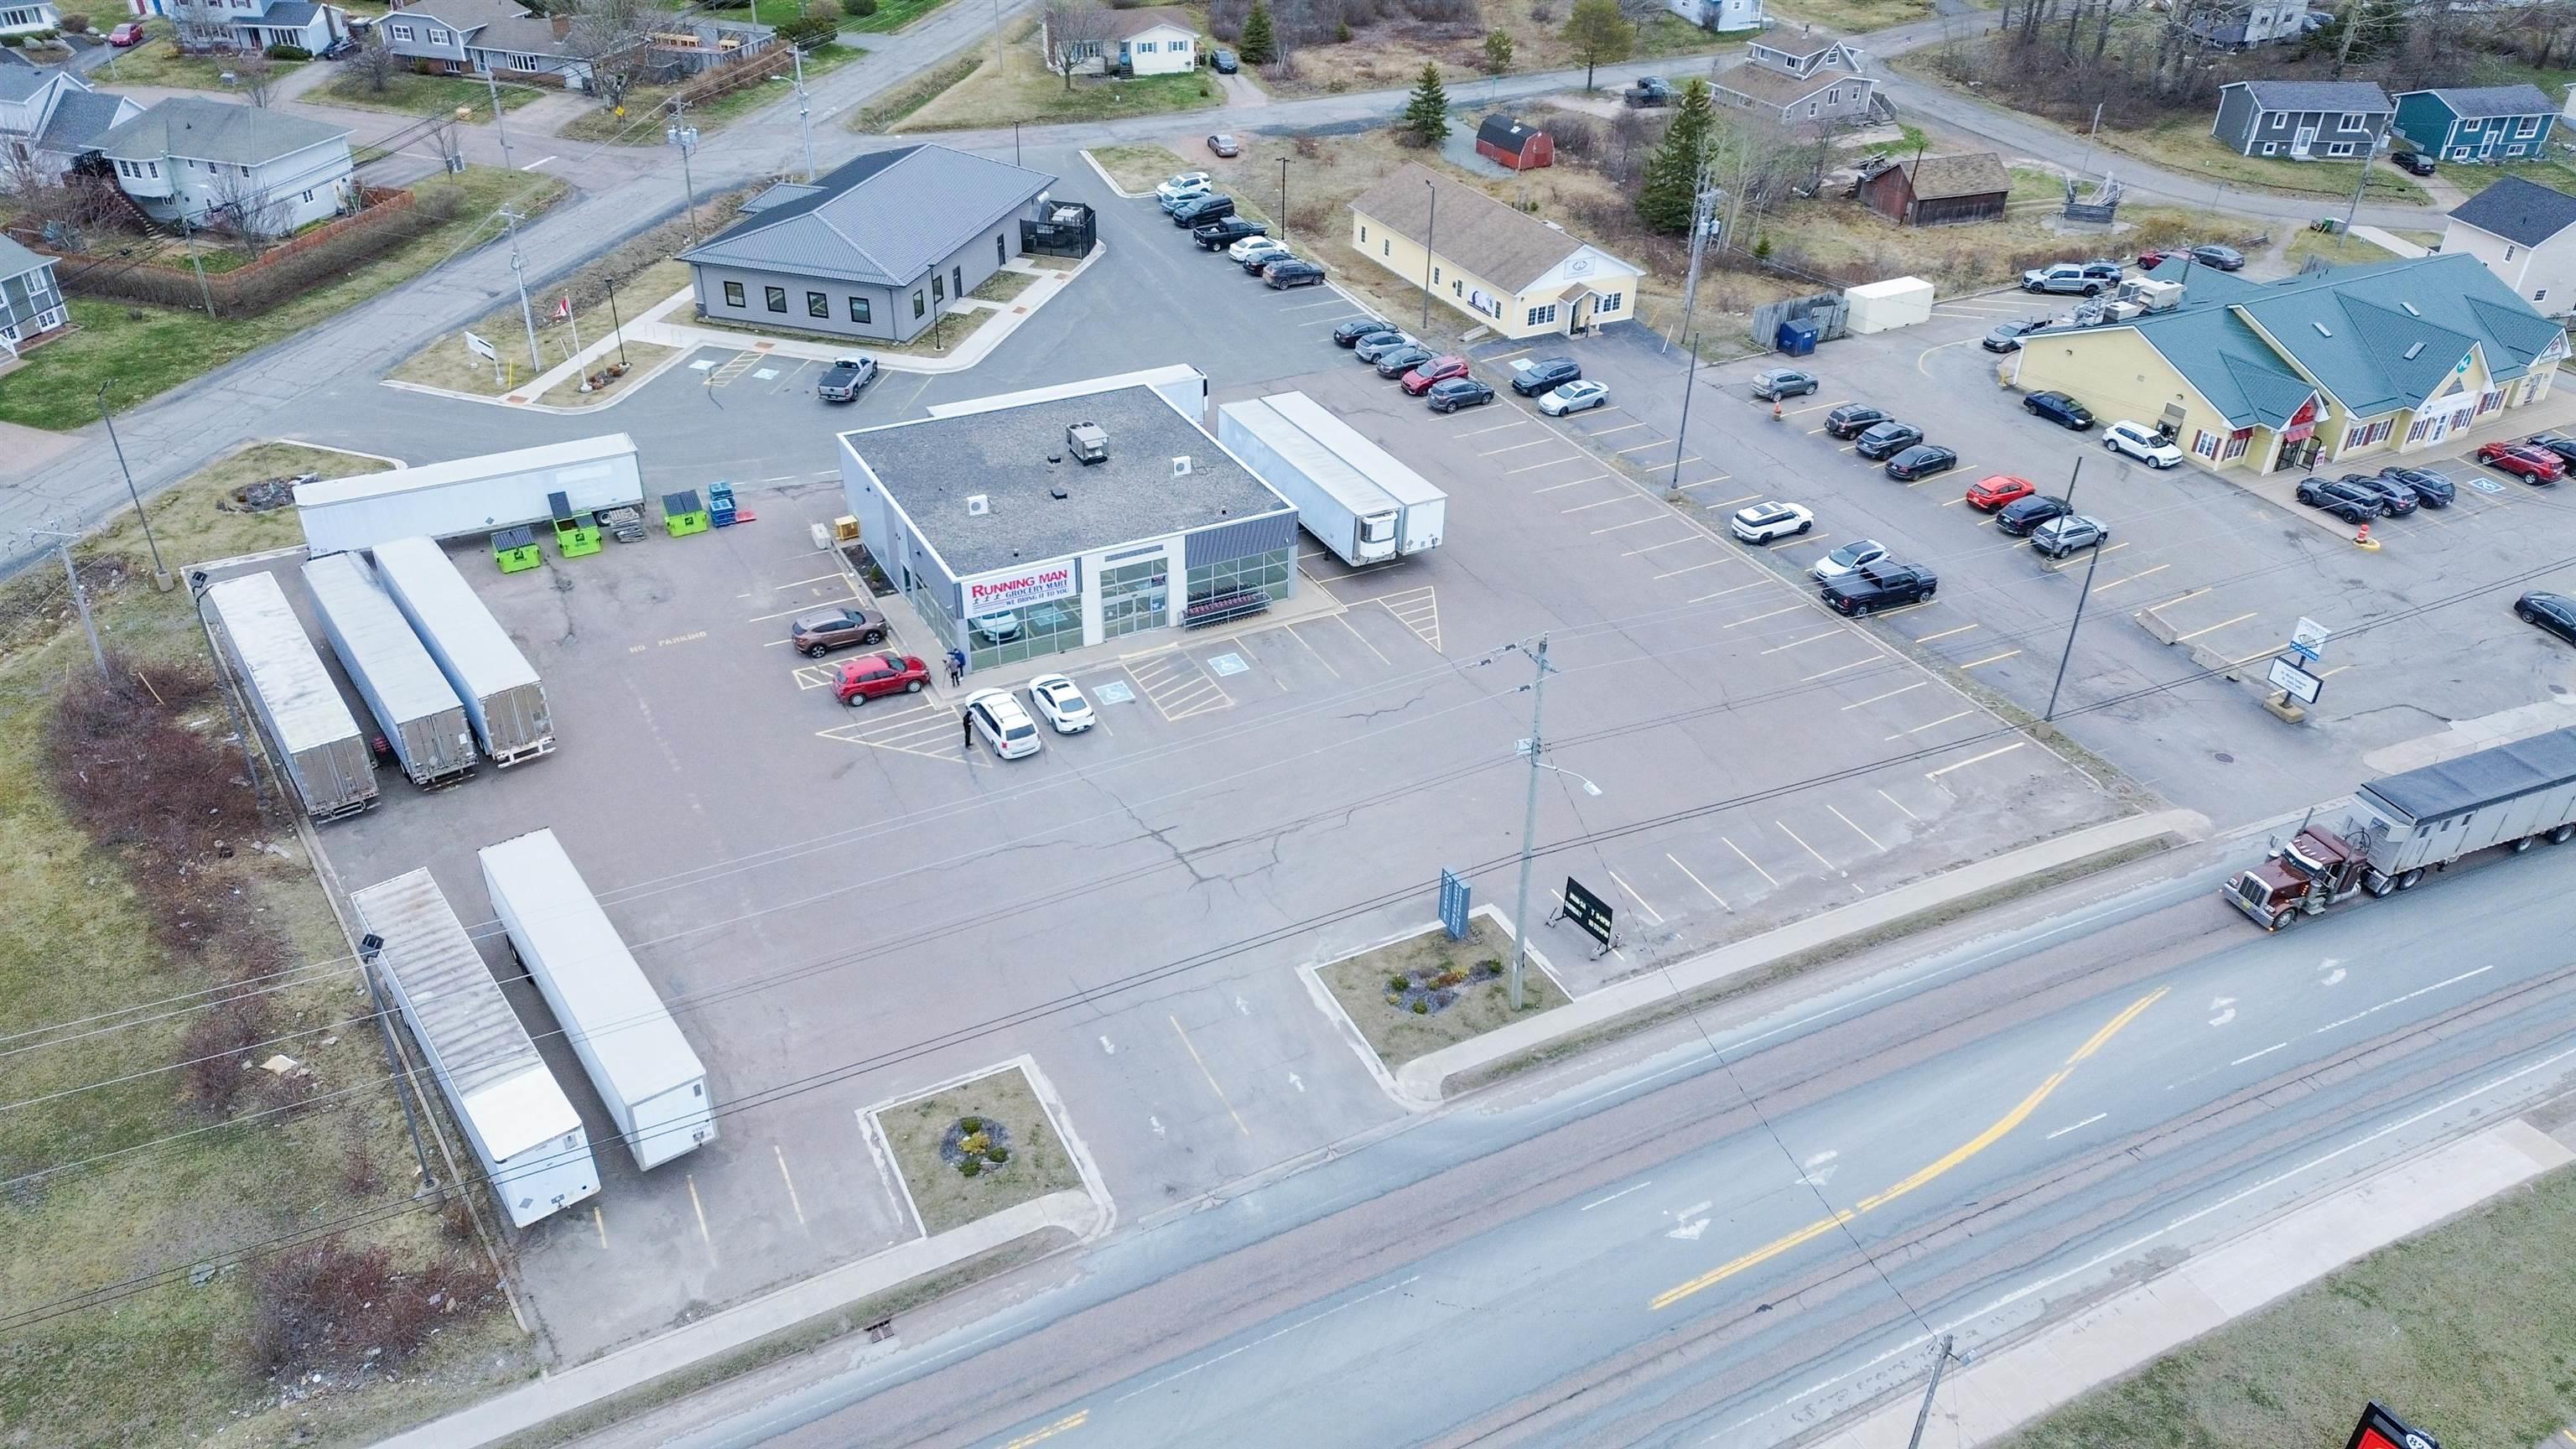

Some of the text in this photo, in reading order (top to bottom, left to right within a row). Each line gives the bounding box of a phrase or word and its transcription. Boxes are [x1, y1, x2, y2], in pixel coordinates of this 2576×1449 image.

[972, 569, 1067, 598] RUNNING MAN
[1005, 579, 1067, 598] GROCERY MART
